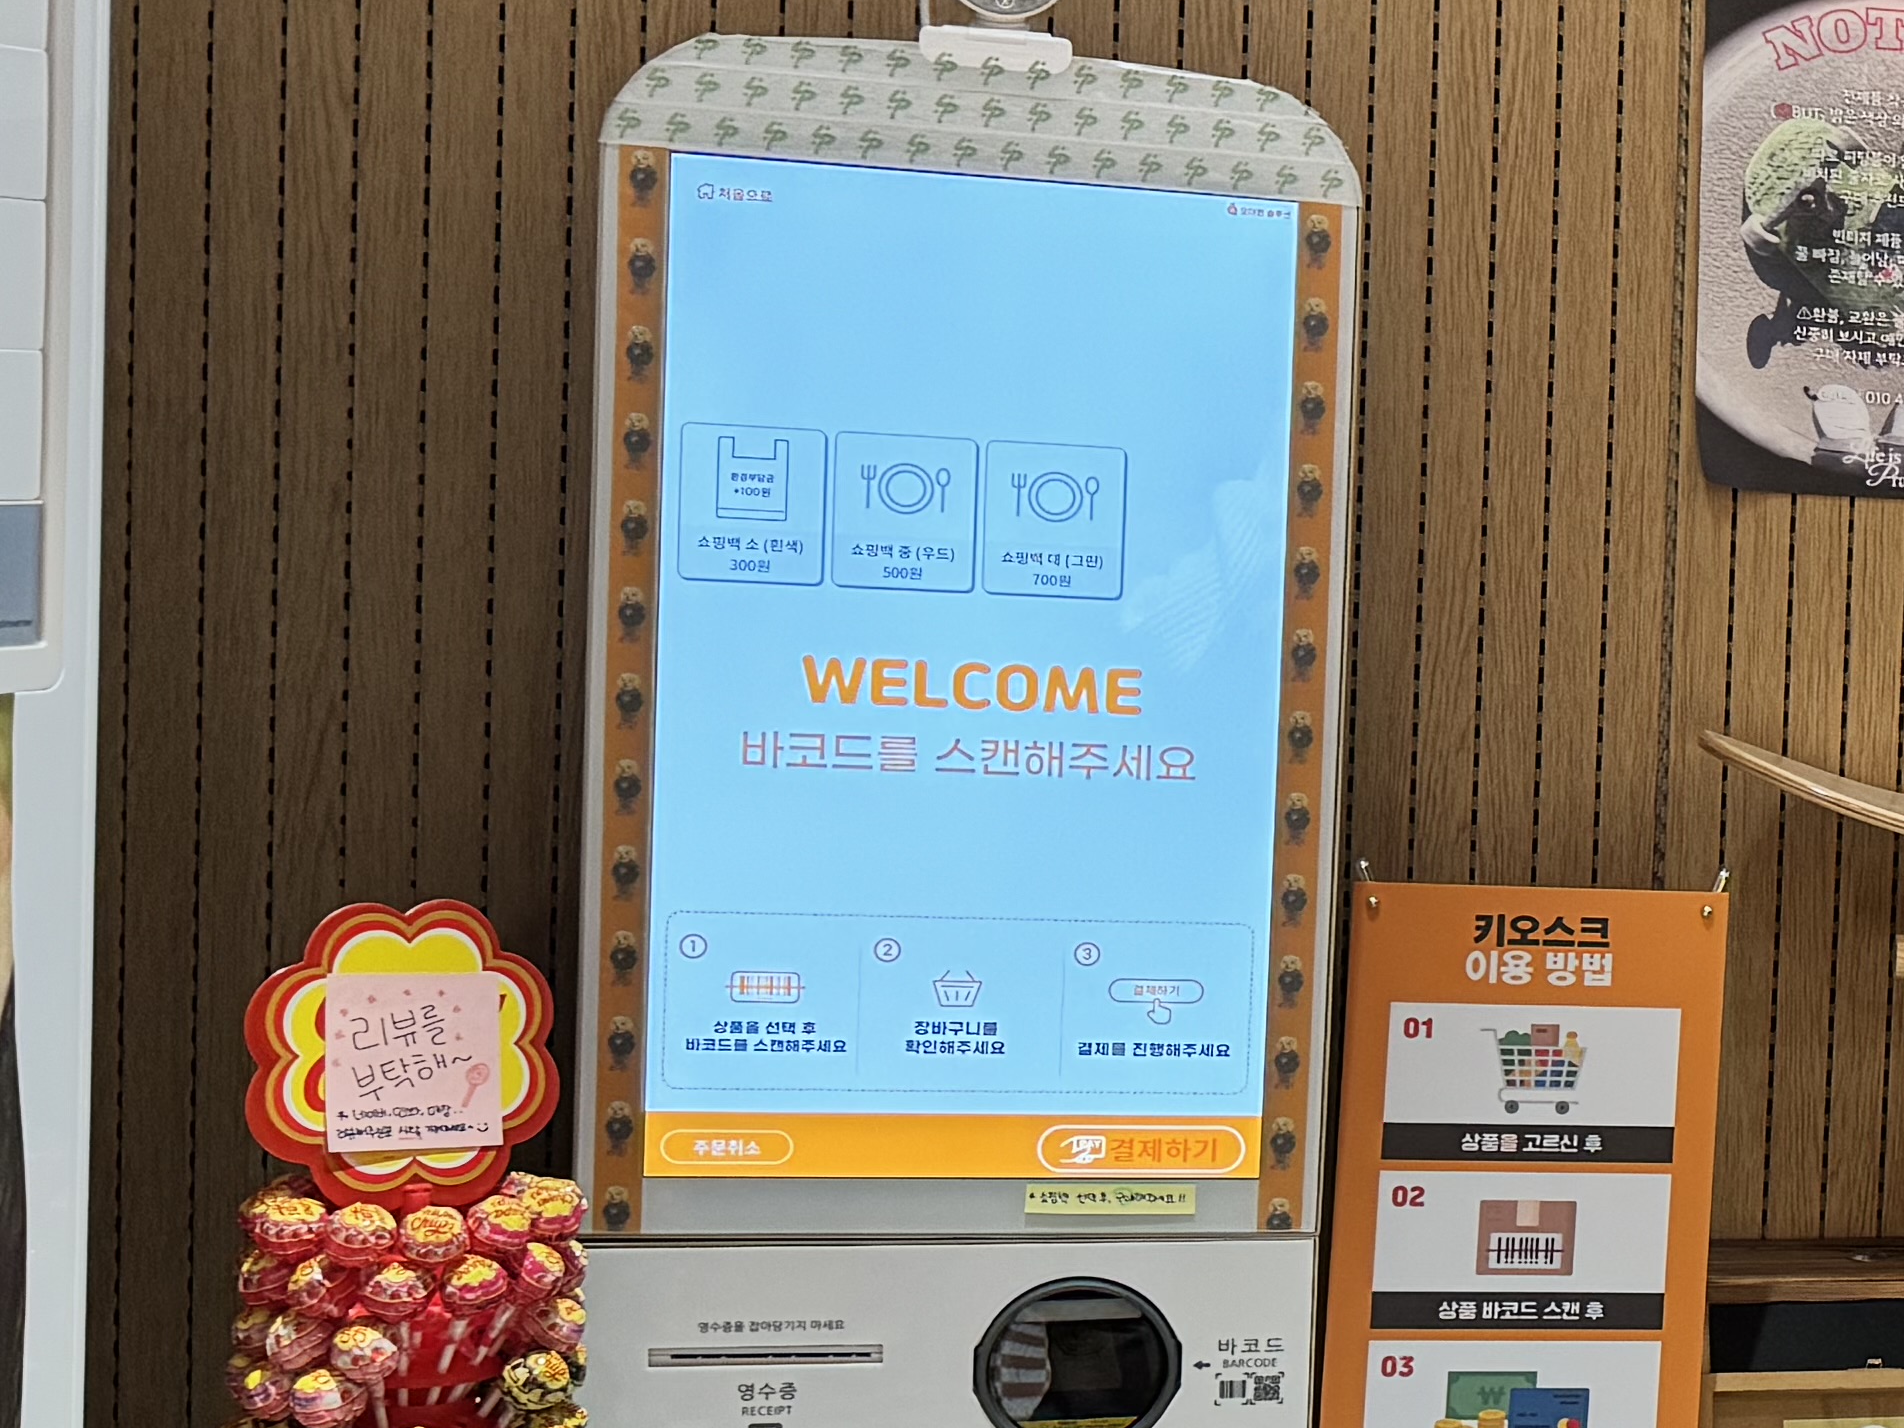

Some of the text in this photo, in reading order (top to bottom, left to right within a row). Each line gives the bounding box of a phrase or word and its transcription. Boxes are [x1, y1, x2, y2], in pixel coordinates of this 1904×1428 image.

[1865, 390, 1891, 405] 010
[698, 535, 804, 554] 쇼핑백 소 (흰색)
[851, 543, 956, 563] 쇼핑백 중 (우드)
[729, 558, 770, 573] 300원
[1001, 552, 1043, 568] 쇼핑백
[1065, 553, 1104, 570] (그린)
[882, 565, 923, 580] 500원
[1032, 573, 1072, 588] 700원
[802, 655, 1143, 716] WELCOME
[741, 730, 1196, 781] 바코드를 스캔해주세요
[1474, 913, 1610, 948] 키오스크
[1465, 950, 1613, 987] 이용 방법
[350, 1003, 447, 1051] 리뷰를
[713, 1021, 817, 1036] 상품을 선택 후
[914, 1021, 998, 1037] 장바구니를
[1402, 1016, 1434, 1039] 01
[685, 1038, 848, 1053] 바코드를 스캔해주세요
[905, 1039, 1006, 1055] 확인해주세요
[1077, 1041, 1231, 1058] 결제를 진행해주세요
[692, 1138, 762, 1157] 주문취소
[1109, 1136, 1218, 1164] 결제하기
[1461, 1133, 1603, 1153] 상품을 고르신 후
[1391, 1185, 1426, 1208] 02
[1438, 1300, 1604, 1320] 상품 바코드 스캔 후
[698, 1320, 746, 1334] 영수증을
[810, 1318, 845, 1332] 마세요
[1217, 1337, 1285, 1355] 바코드
[1222, 1358, 1278, 1368] BARCODE
[1380, 1354, 1415, 1378] 03
[737, 1381, 798, 1402] 영수증
[741, 1404, 793, 1416] RECEIPT
